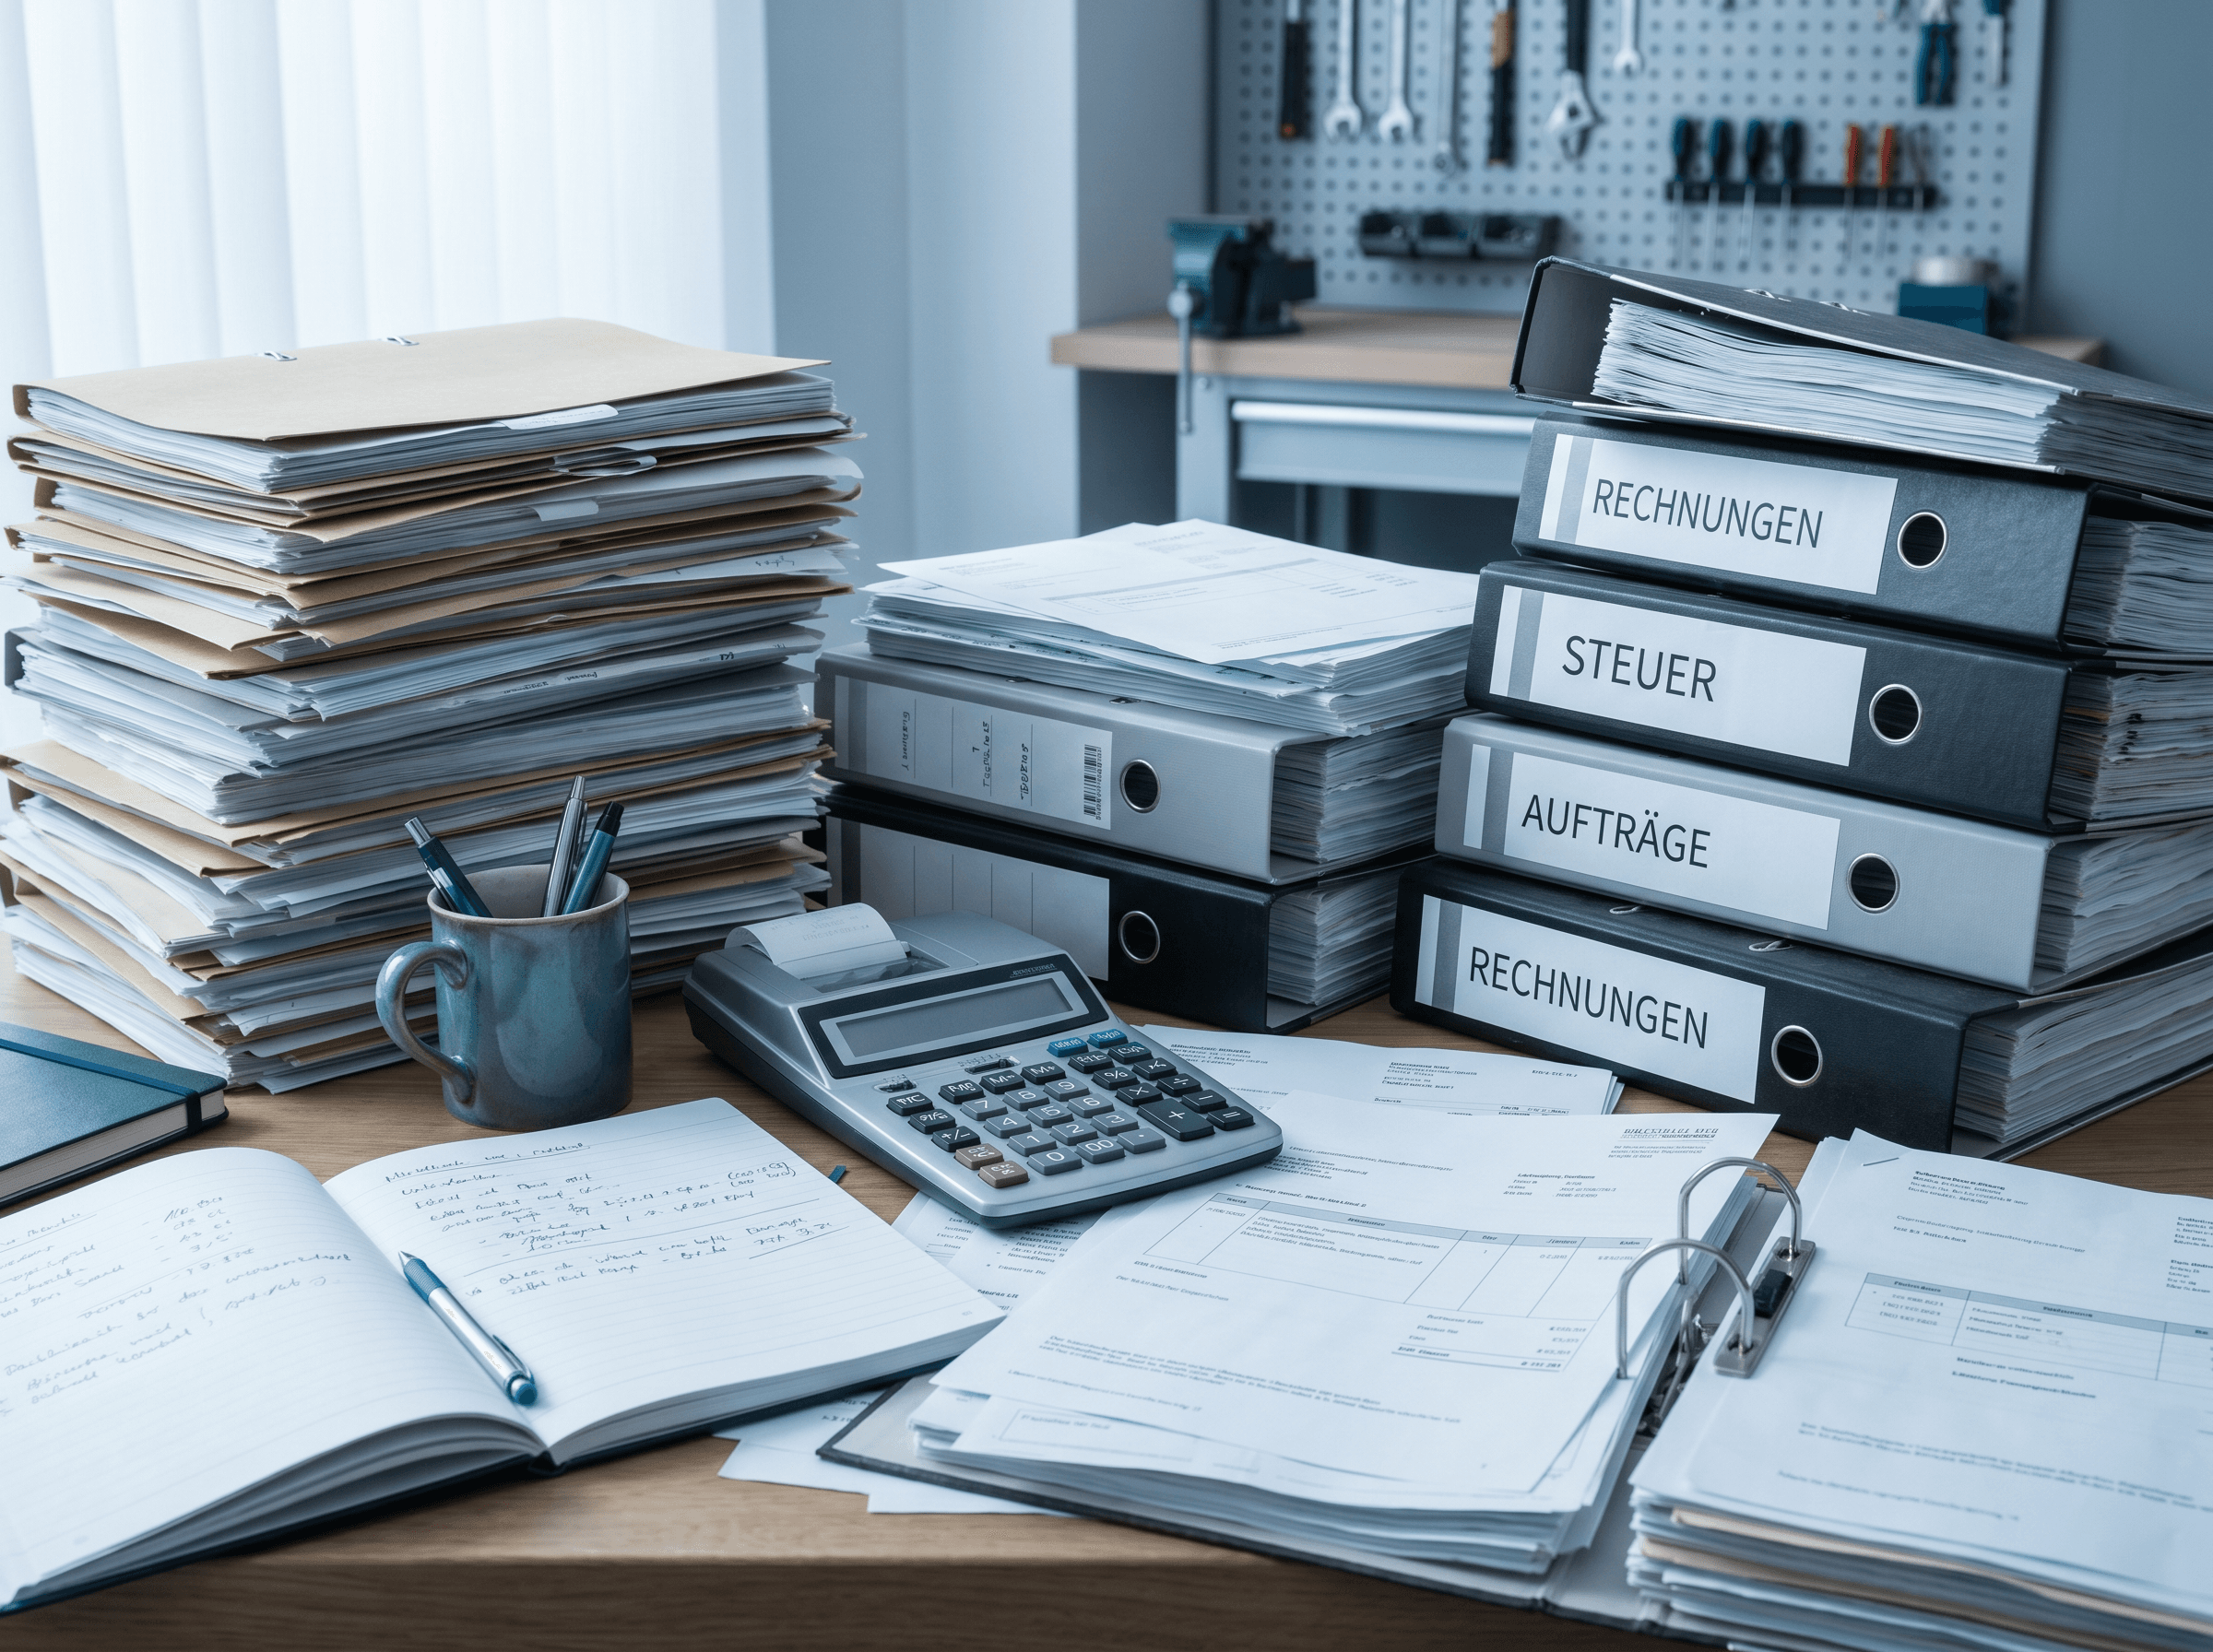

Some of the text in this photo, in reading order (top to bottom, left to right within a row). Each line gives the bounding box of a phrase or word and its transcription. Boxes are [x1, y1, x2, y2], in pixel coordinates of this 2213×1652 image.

[1592, 478, 1823, 549] RECHNUNGEN
[1562, 635, 1717, 702] STEUER
[1521, 794, 1711, 867] AUFTRÄGE
[1470, 947, 1709, 1049] RECHNUNGEN
[974, 1100, 988, 1109] 7
[1083, 1097, 1101, 1106] 6
[1002, 1117, 1018, 1126] 4
[1066, 1124, 1084, 1134] 2
[1084, 1139, 1114, 1151] 00
[1046, 1151, 1065, 1162] 0
